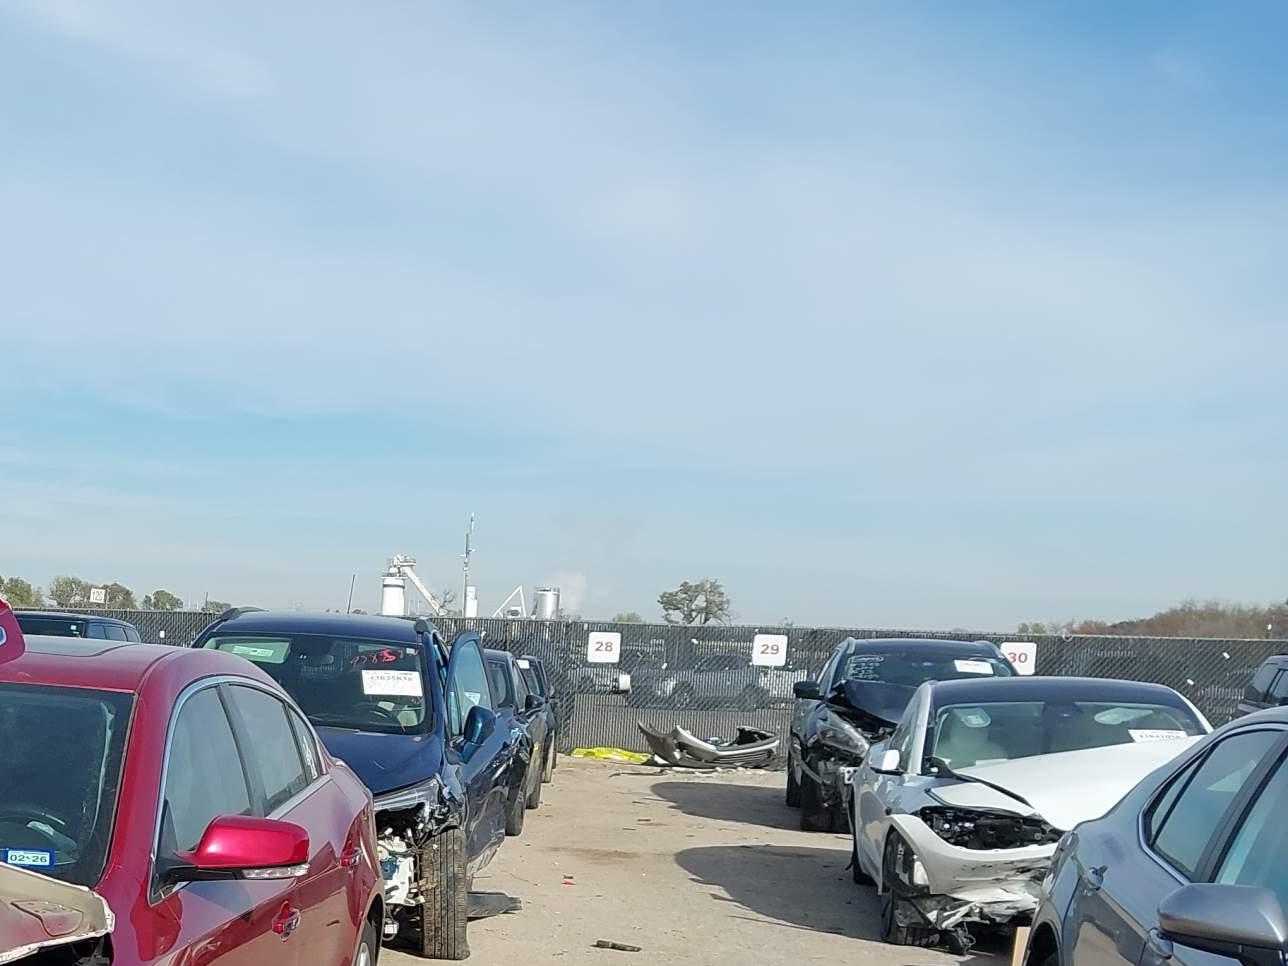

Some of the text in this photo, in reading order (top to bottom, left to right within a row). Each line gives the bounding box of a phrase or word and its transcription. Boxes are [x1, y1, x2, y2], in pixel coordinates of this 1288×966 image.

[594, 641, 614, 652] 28
[760, 643, 780, 655] 29
[1007, 652, 1028, 663] 30
